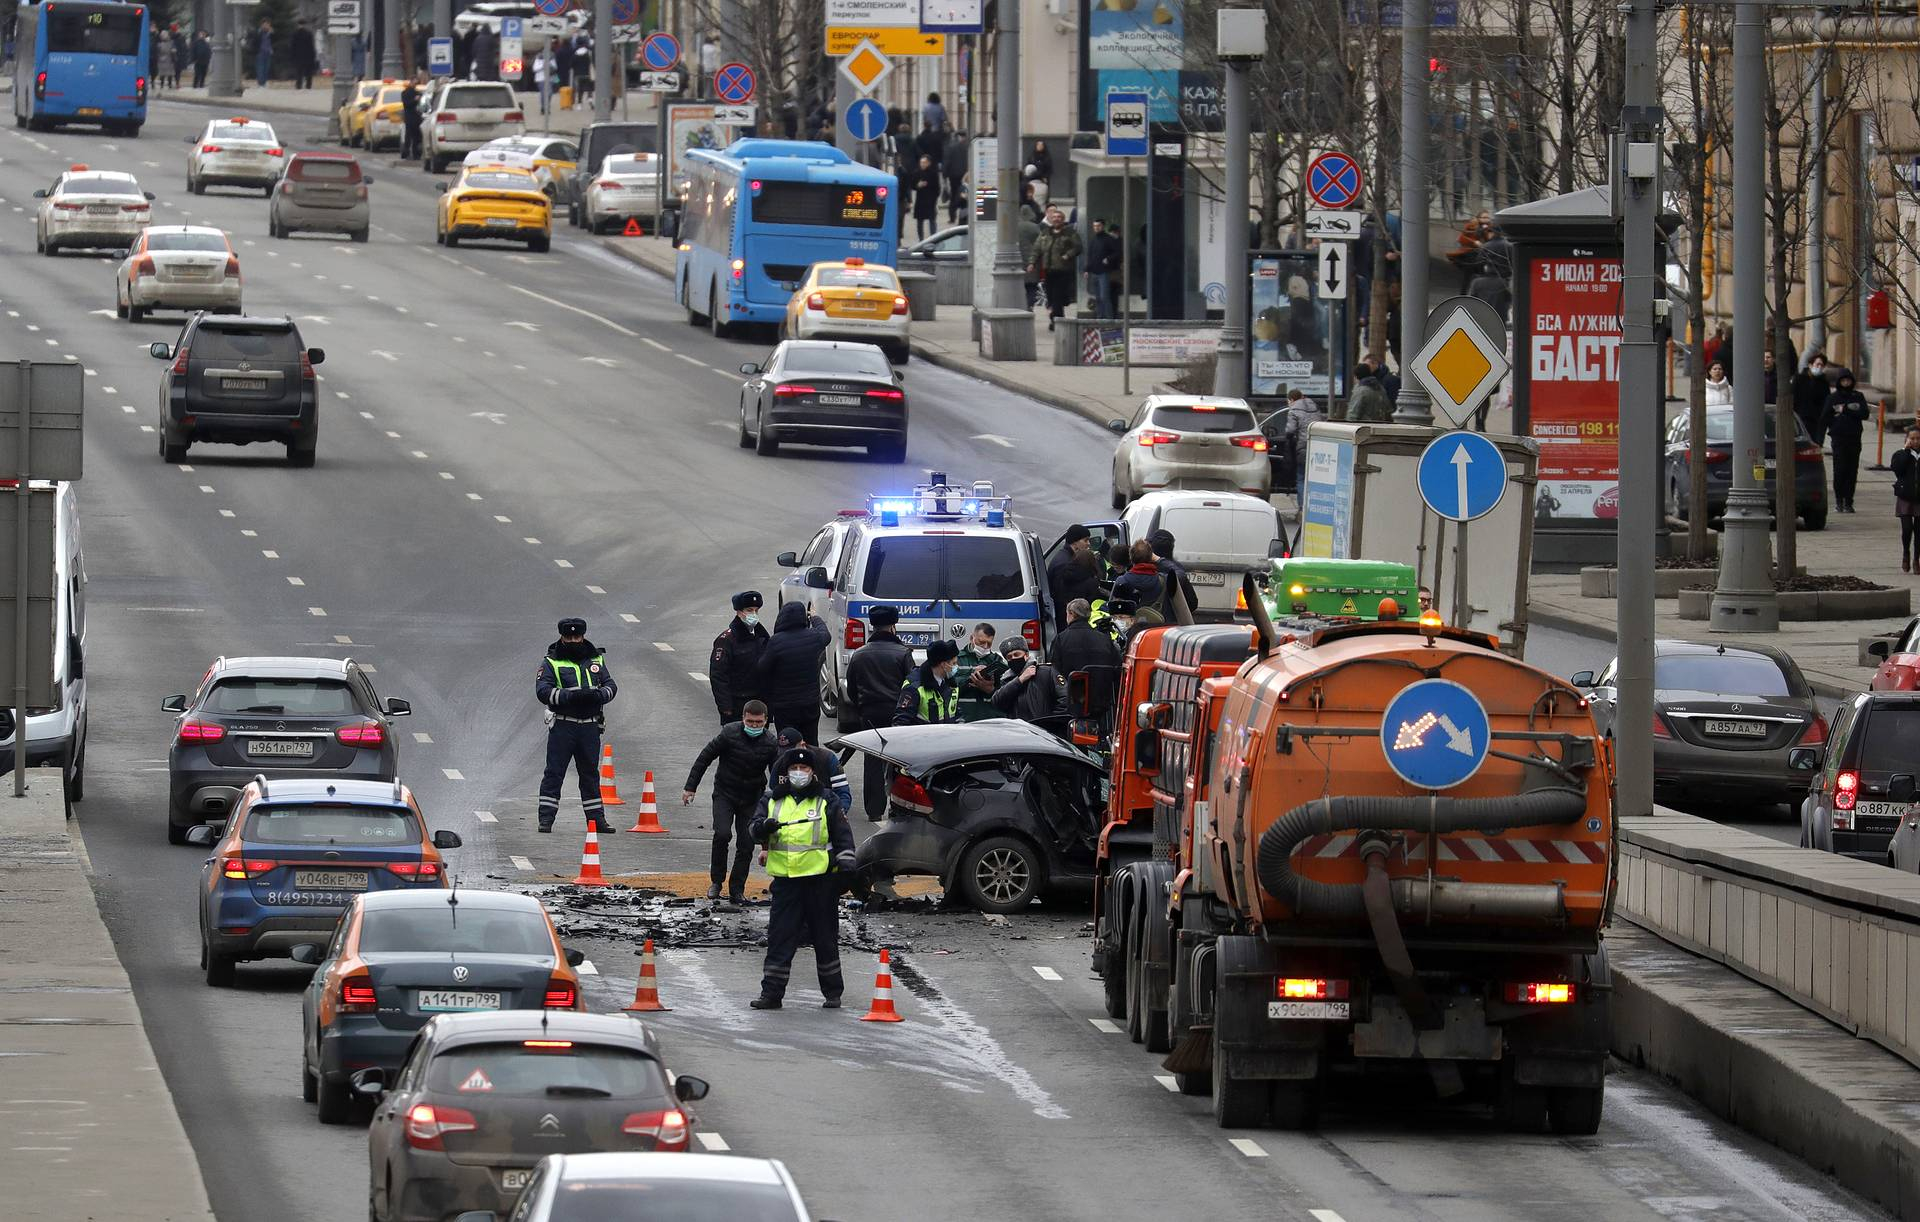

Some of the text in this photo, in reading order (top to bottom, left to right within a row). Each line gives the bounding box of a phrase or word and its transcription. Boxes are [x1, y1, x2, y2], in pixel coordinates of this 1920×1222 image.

[847, 0, 907, 9] СМОЛЕНСКИЙ
[832, 11, 870, 19] переулок
[832, 32, 881, 40] ЕВРОСПАР
[1541, 264, 1551, 282] 3
[1555, 263, 1595, 282] ИЮЛЯ
[1565, 284, 1588, 293] НАЧАЛО
[1536, 314, 1562, 331] БСА
[1579, 422, 1603, 435] 198
